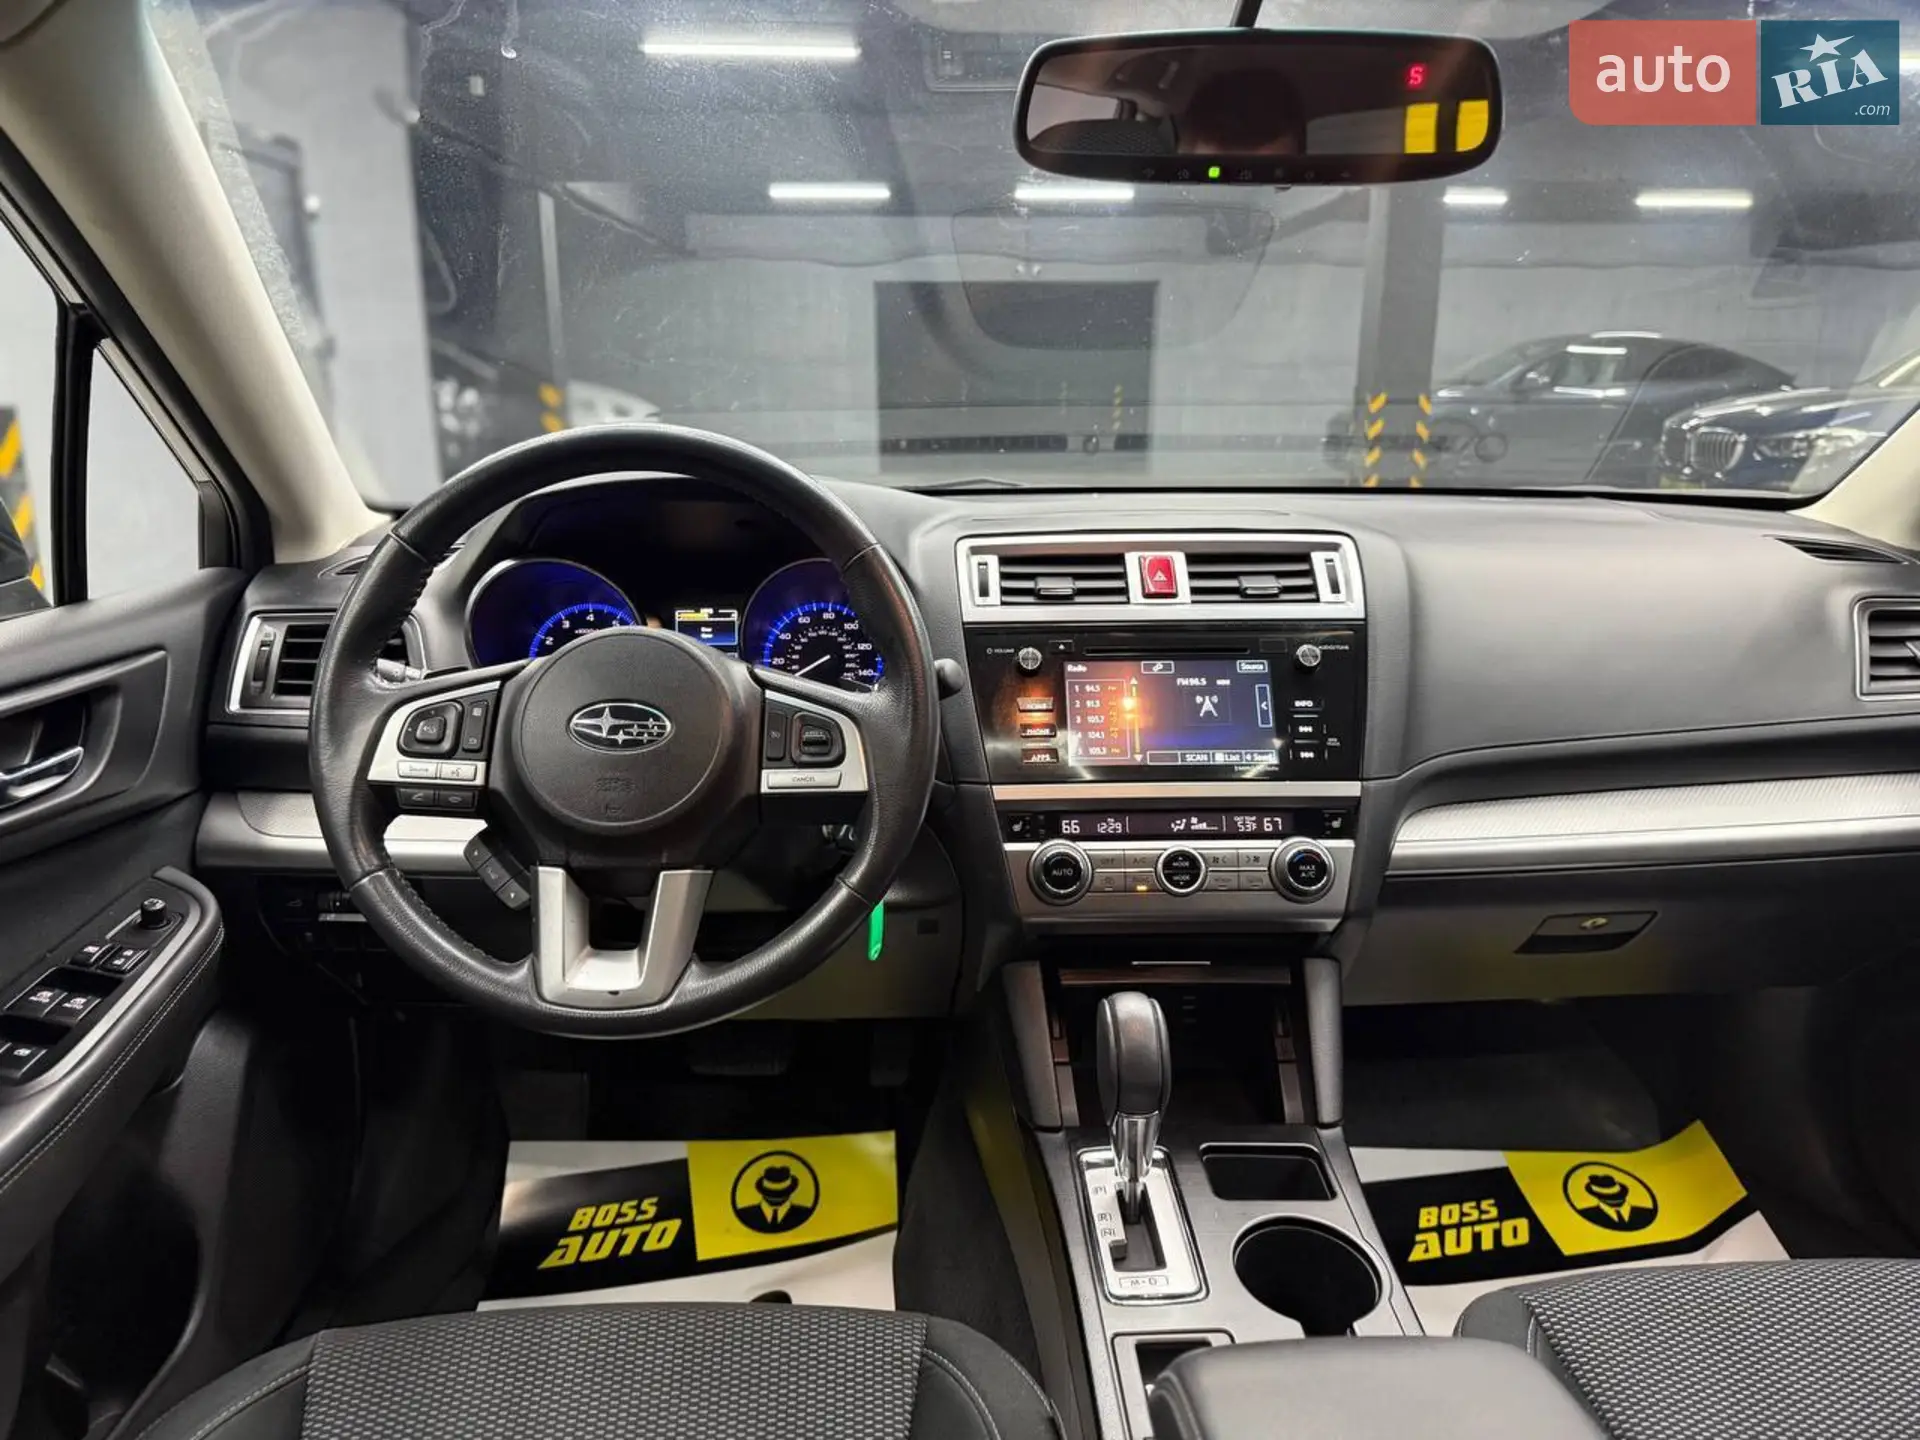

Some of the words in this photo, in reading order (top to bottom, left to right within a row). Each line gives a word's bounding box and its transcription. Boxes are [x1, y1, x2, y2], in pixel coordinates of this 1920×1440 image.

[586, 613, 594, 621] 4
[798, 616, 811, 624] 60
[562, 620, 570, 628] 3
[844, 622, 859, 630] 100
[545, 637, 554, 645] 2
[1062, 820, 1080, 834] 66
[1264, 817, 1282, 831] 67
[1052, 867, 1073, 876] AUTO
[567, 1197, 658, 1232] BOSS
[1418, 1199, 1498, 1229] BOSS
[538, 1219, 682, 1269] AUTO
[1407, 1217, 1530, 1262] AUTO
